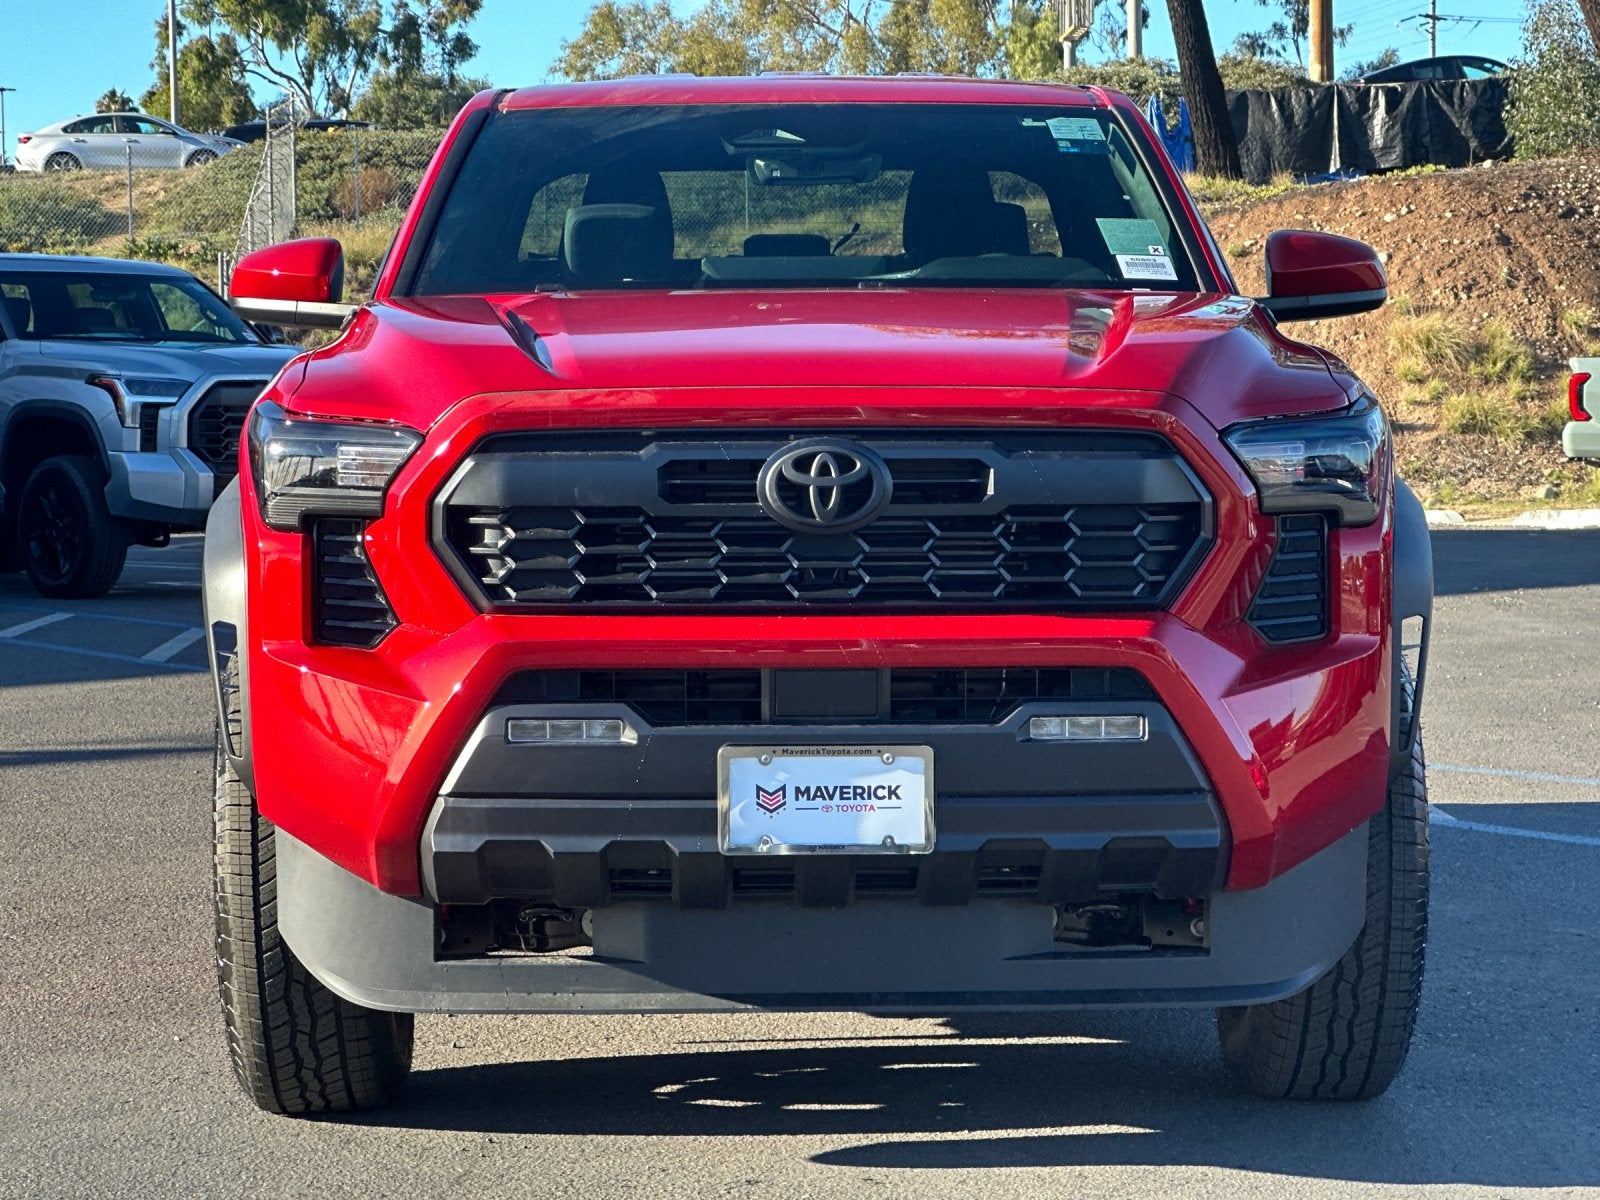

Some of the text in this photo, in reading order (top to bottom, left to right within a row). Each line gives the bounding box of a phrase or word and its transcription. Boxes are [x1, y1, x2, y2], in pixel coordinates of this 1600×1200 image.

[782, 748, 872, 756] MaverickToyota.com
[794, 785, 902, 801] MAVERICK
[835, 804, 876, 813] TOYOTA
